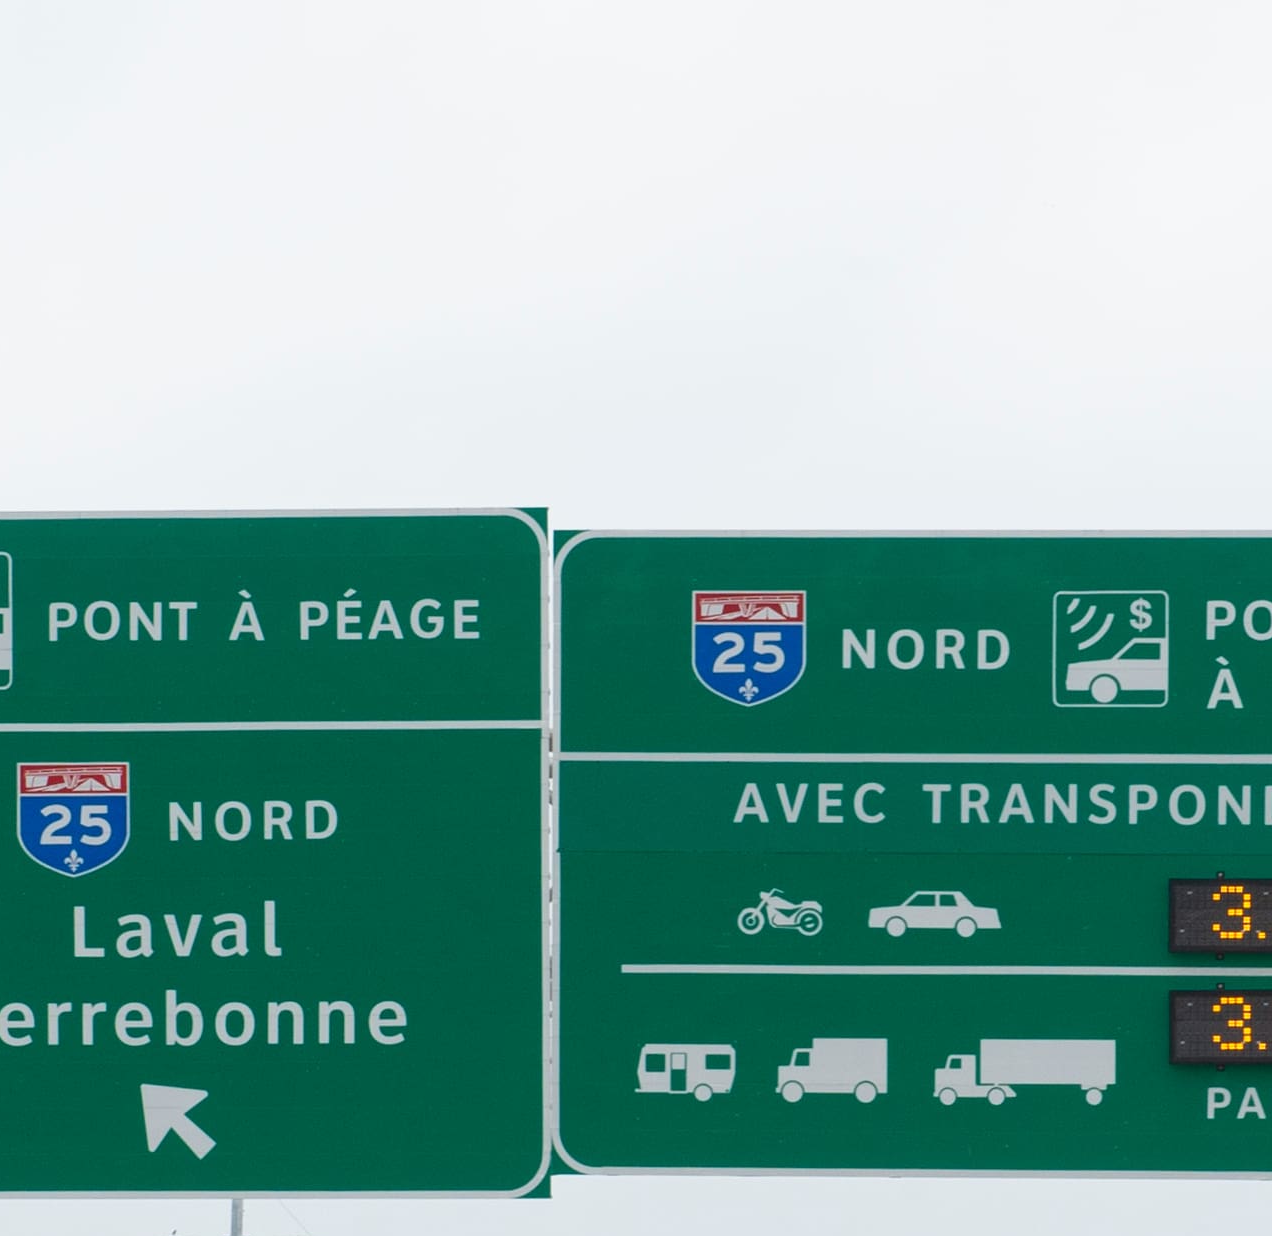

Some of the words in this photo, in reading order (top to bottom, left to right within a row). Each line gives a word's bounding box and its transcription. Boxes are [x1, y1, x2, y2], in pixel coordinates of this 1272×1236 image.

[49, 601, 196, 641] PONT
[230, 591, 263, 640] À
[301, 589, 479, 639] PÉAGE
[713, 633, 784, 672] 25
[843, 629, 1009, 669] NORD
[1208, 660, 1242, 708] À
[41, 805, 111, 845] 25
[170, 801, 337, 840] NORD
[734, 783, 885, 823] AVEC
[74, 901, 281, 957] Laval
